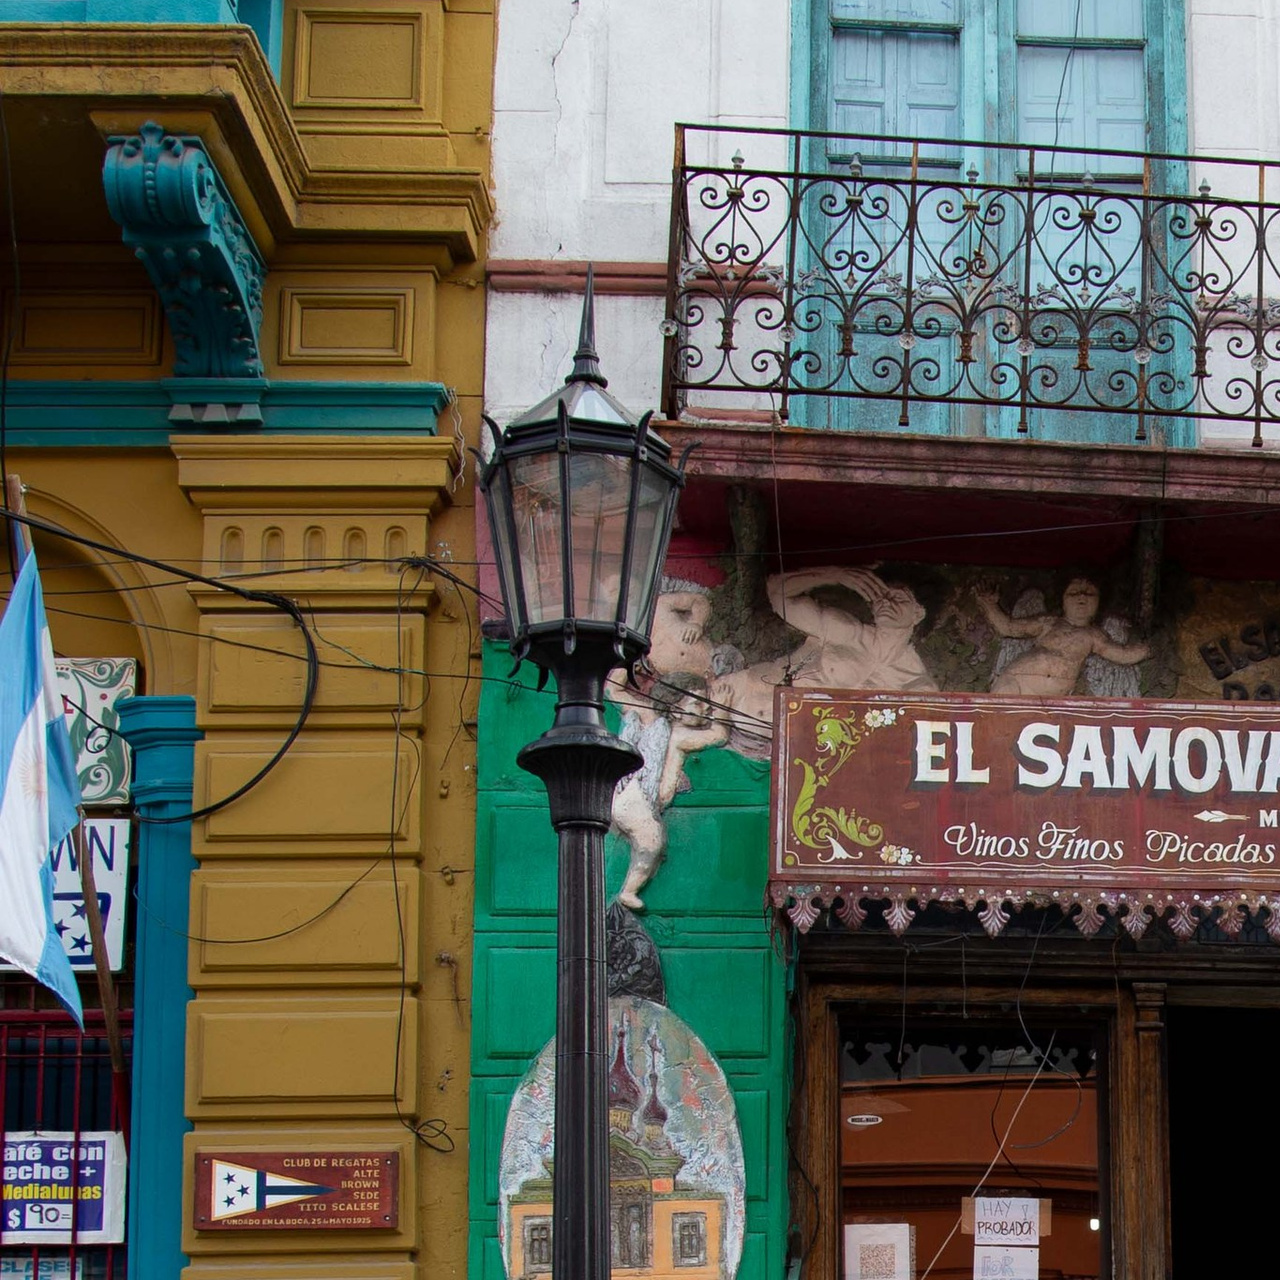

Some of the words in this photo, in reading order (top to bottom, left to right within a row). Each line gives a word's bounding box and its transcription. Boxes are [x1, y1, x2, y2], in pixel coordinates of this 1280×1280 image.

[914, 720, 990, 784] EL
[944, 822, 1030, 859] Vinos
[1037, 821, 1124, 862] Finos
[1145, 829, 1276, 864] Picadas
[283, 1158, 311, 1167] CLUB
[313, 1158, 327, 1167] DE
[332, 1158, 380, 1167] REGATAS
[353, 1170, 380, 1178] ALTE
[341, 1180, 380, 1189] BROWN
[353, 1192, 380, 1200] SEDE
[299, 1203, 327, 1212] TITO
[332, 1202, 380, 1212] SCALESE
[982, 1201, 1012, 1217] HAY
[977, 1221, 1036, 1236] PROBADOR
